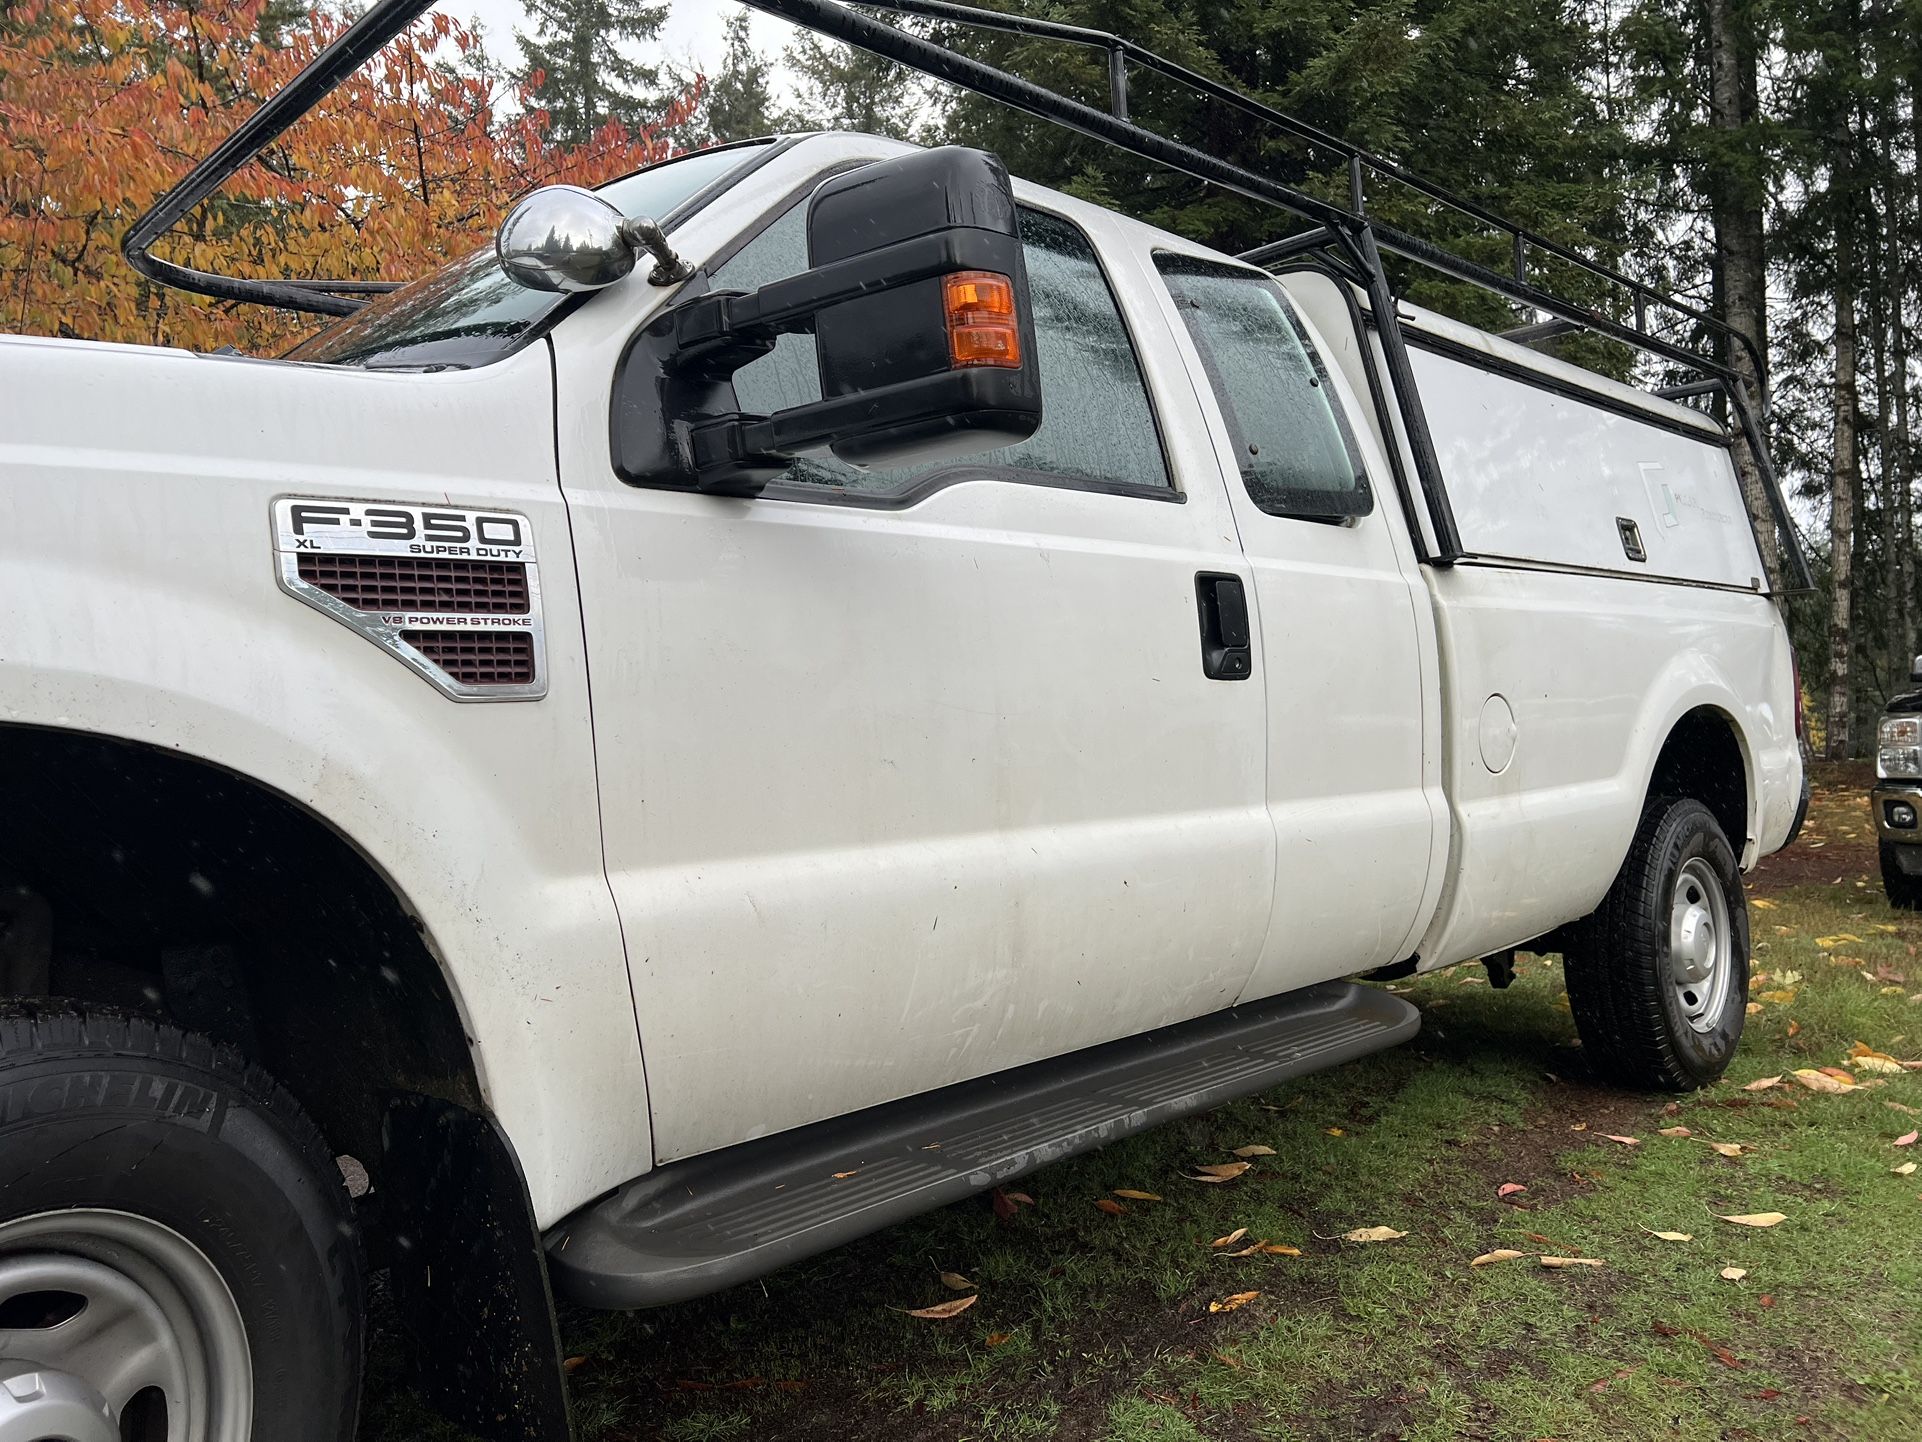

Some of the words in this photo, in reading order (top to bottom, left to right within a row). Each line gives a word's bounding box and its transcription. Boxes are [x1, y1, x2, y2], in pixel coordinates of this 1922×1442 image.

[291, 504, 522, 547] F-350
[295, 538, 321, 550] XL
[409, 543, 471, 556] SUPER
[476, 547, 523, 559] DUTY
[381, 615, 403, 625] V8
[408, 615, 468, 626] POWER
[470, 617, 533, 627] STROKE
[0, 1074, 215, 1124] ICHELIN
